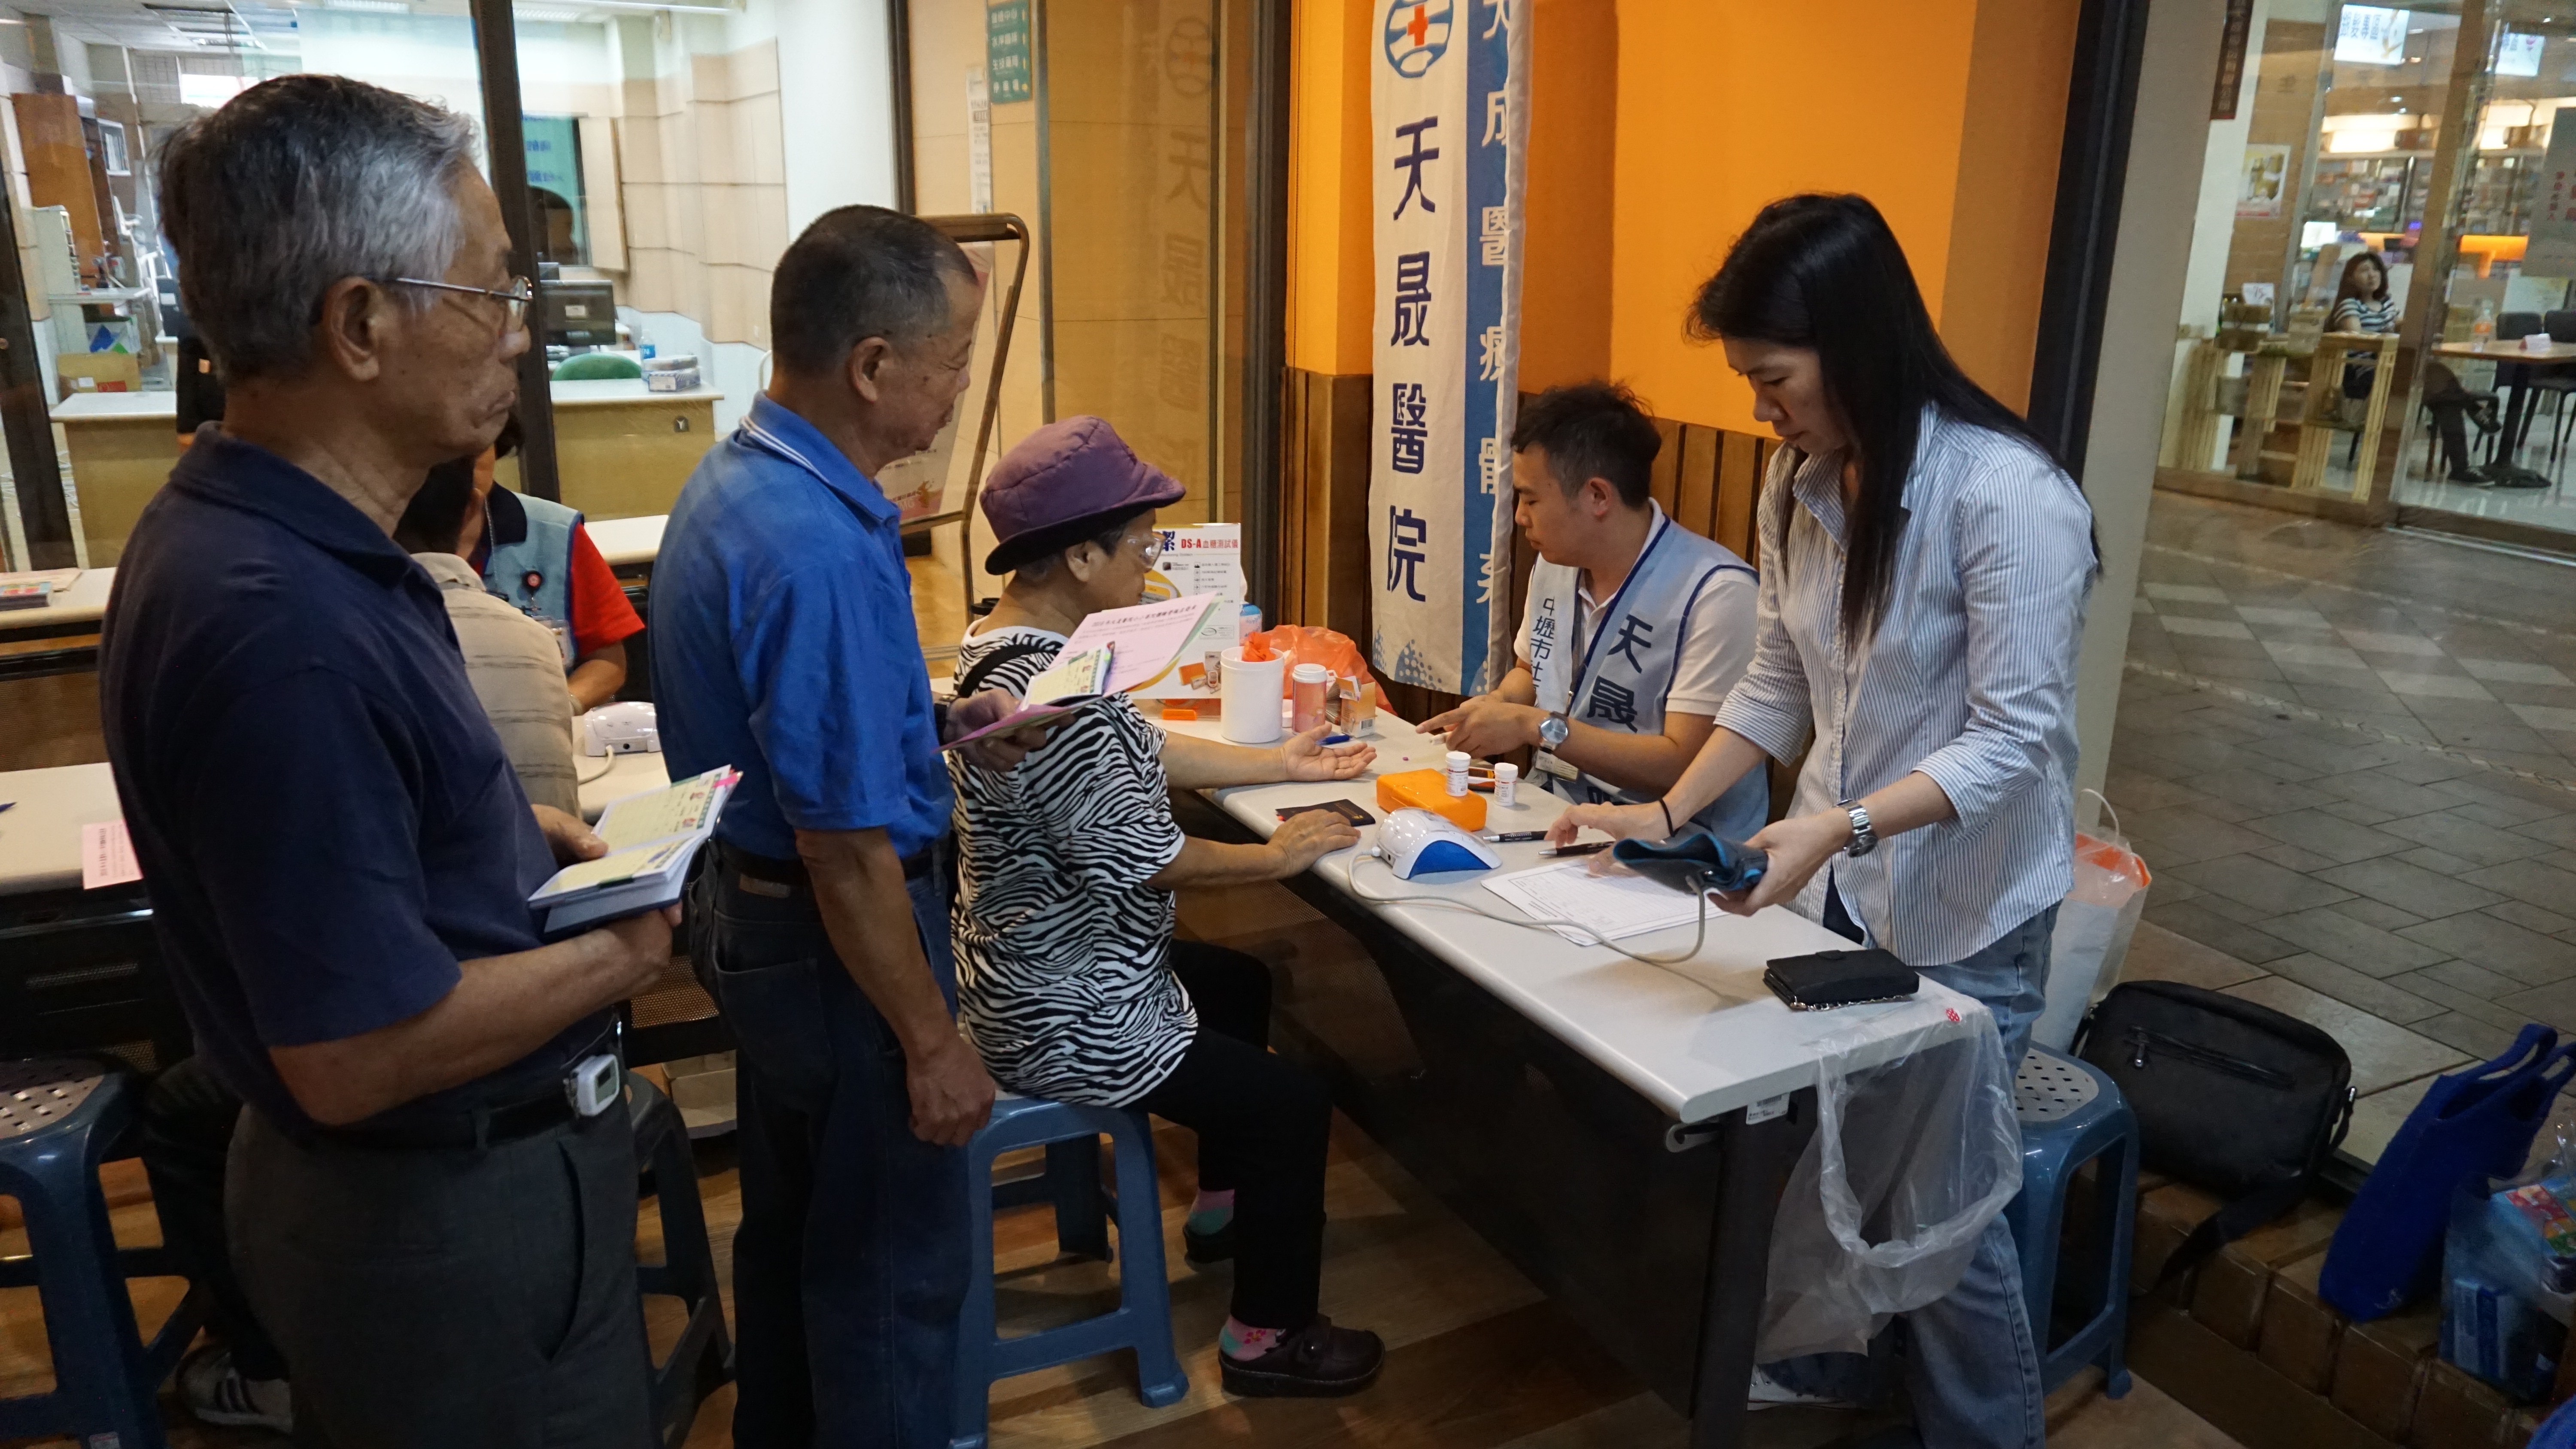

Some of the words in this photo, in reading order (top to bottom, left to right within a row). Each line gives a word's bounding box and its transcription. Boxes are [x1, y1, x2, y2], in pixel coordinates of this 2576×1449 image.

[1387, 115, 1440, 603] 天晟醫院
[1181, 538, 1202, 549] DS-A
[1203, 539, 1238, 549] 血糖測試儀
